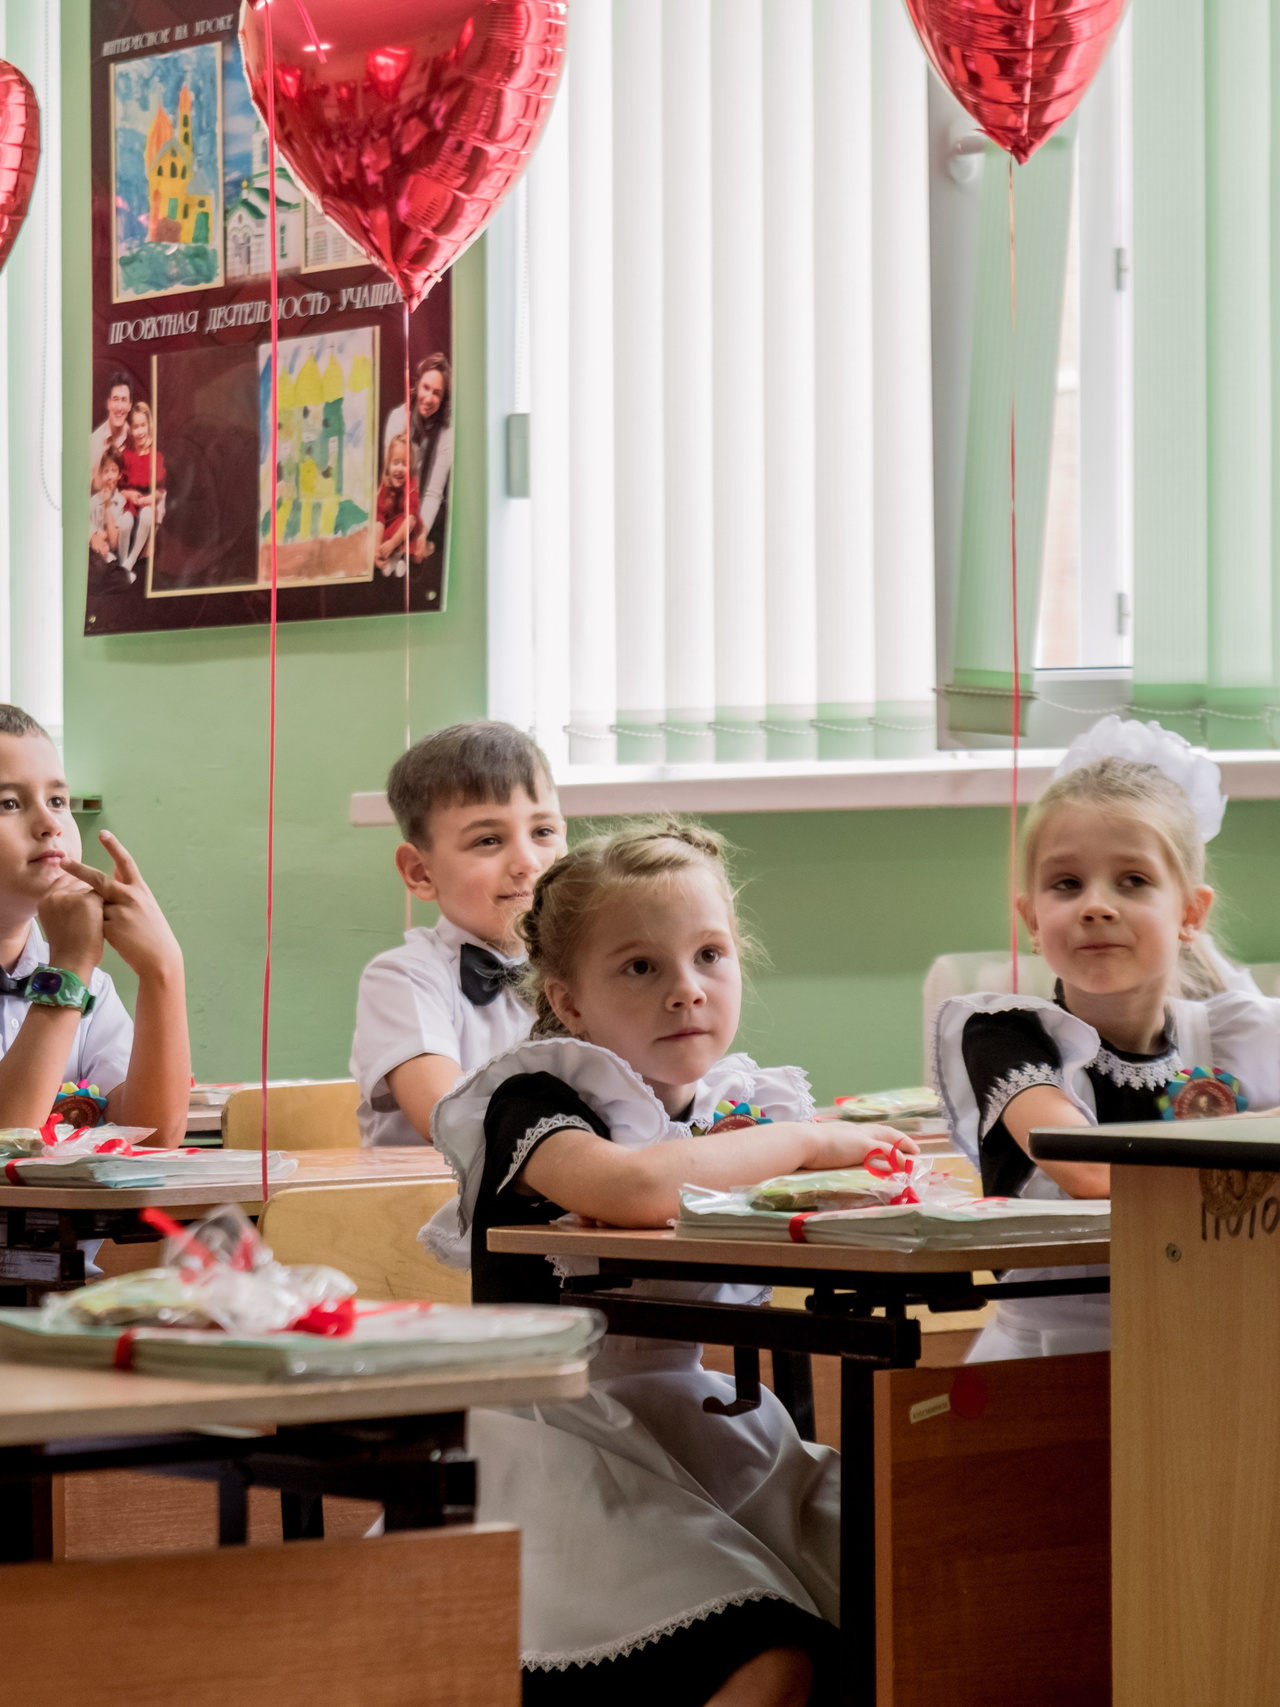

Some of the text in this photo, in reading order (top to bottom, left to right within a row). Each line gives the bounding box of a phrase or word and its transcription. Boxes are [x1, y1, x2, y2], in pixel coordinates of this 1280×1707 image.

[175, 24, 189, 41] НА
[194, 14, 234, 37] УРОКЕ
[109, 281, 429, 345] ПРОЕКТНАЯ ДЕЯТЕЛЬНОСТЬ УЧАЩИХ
